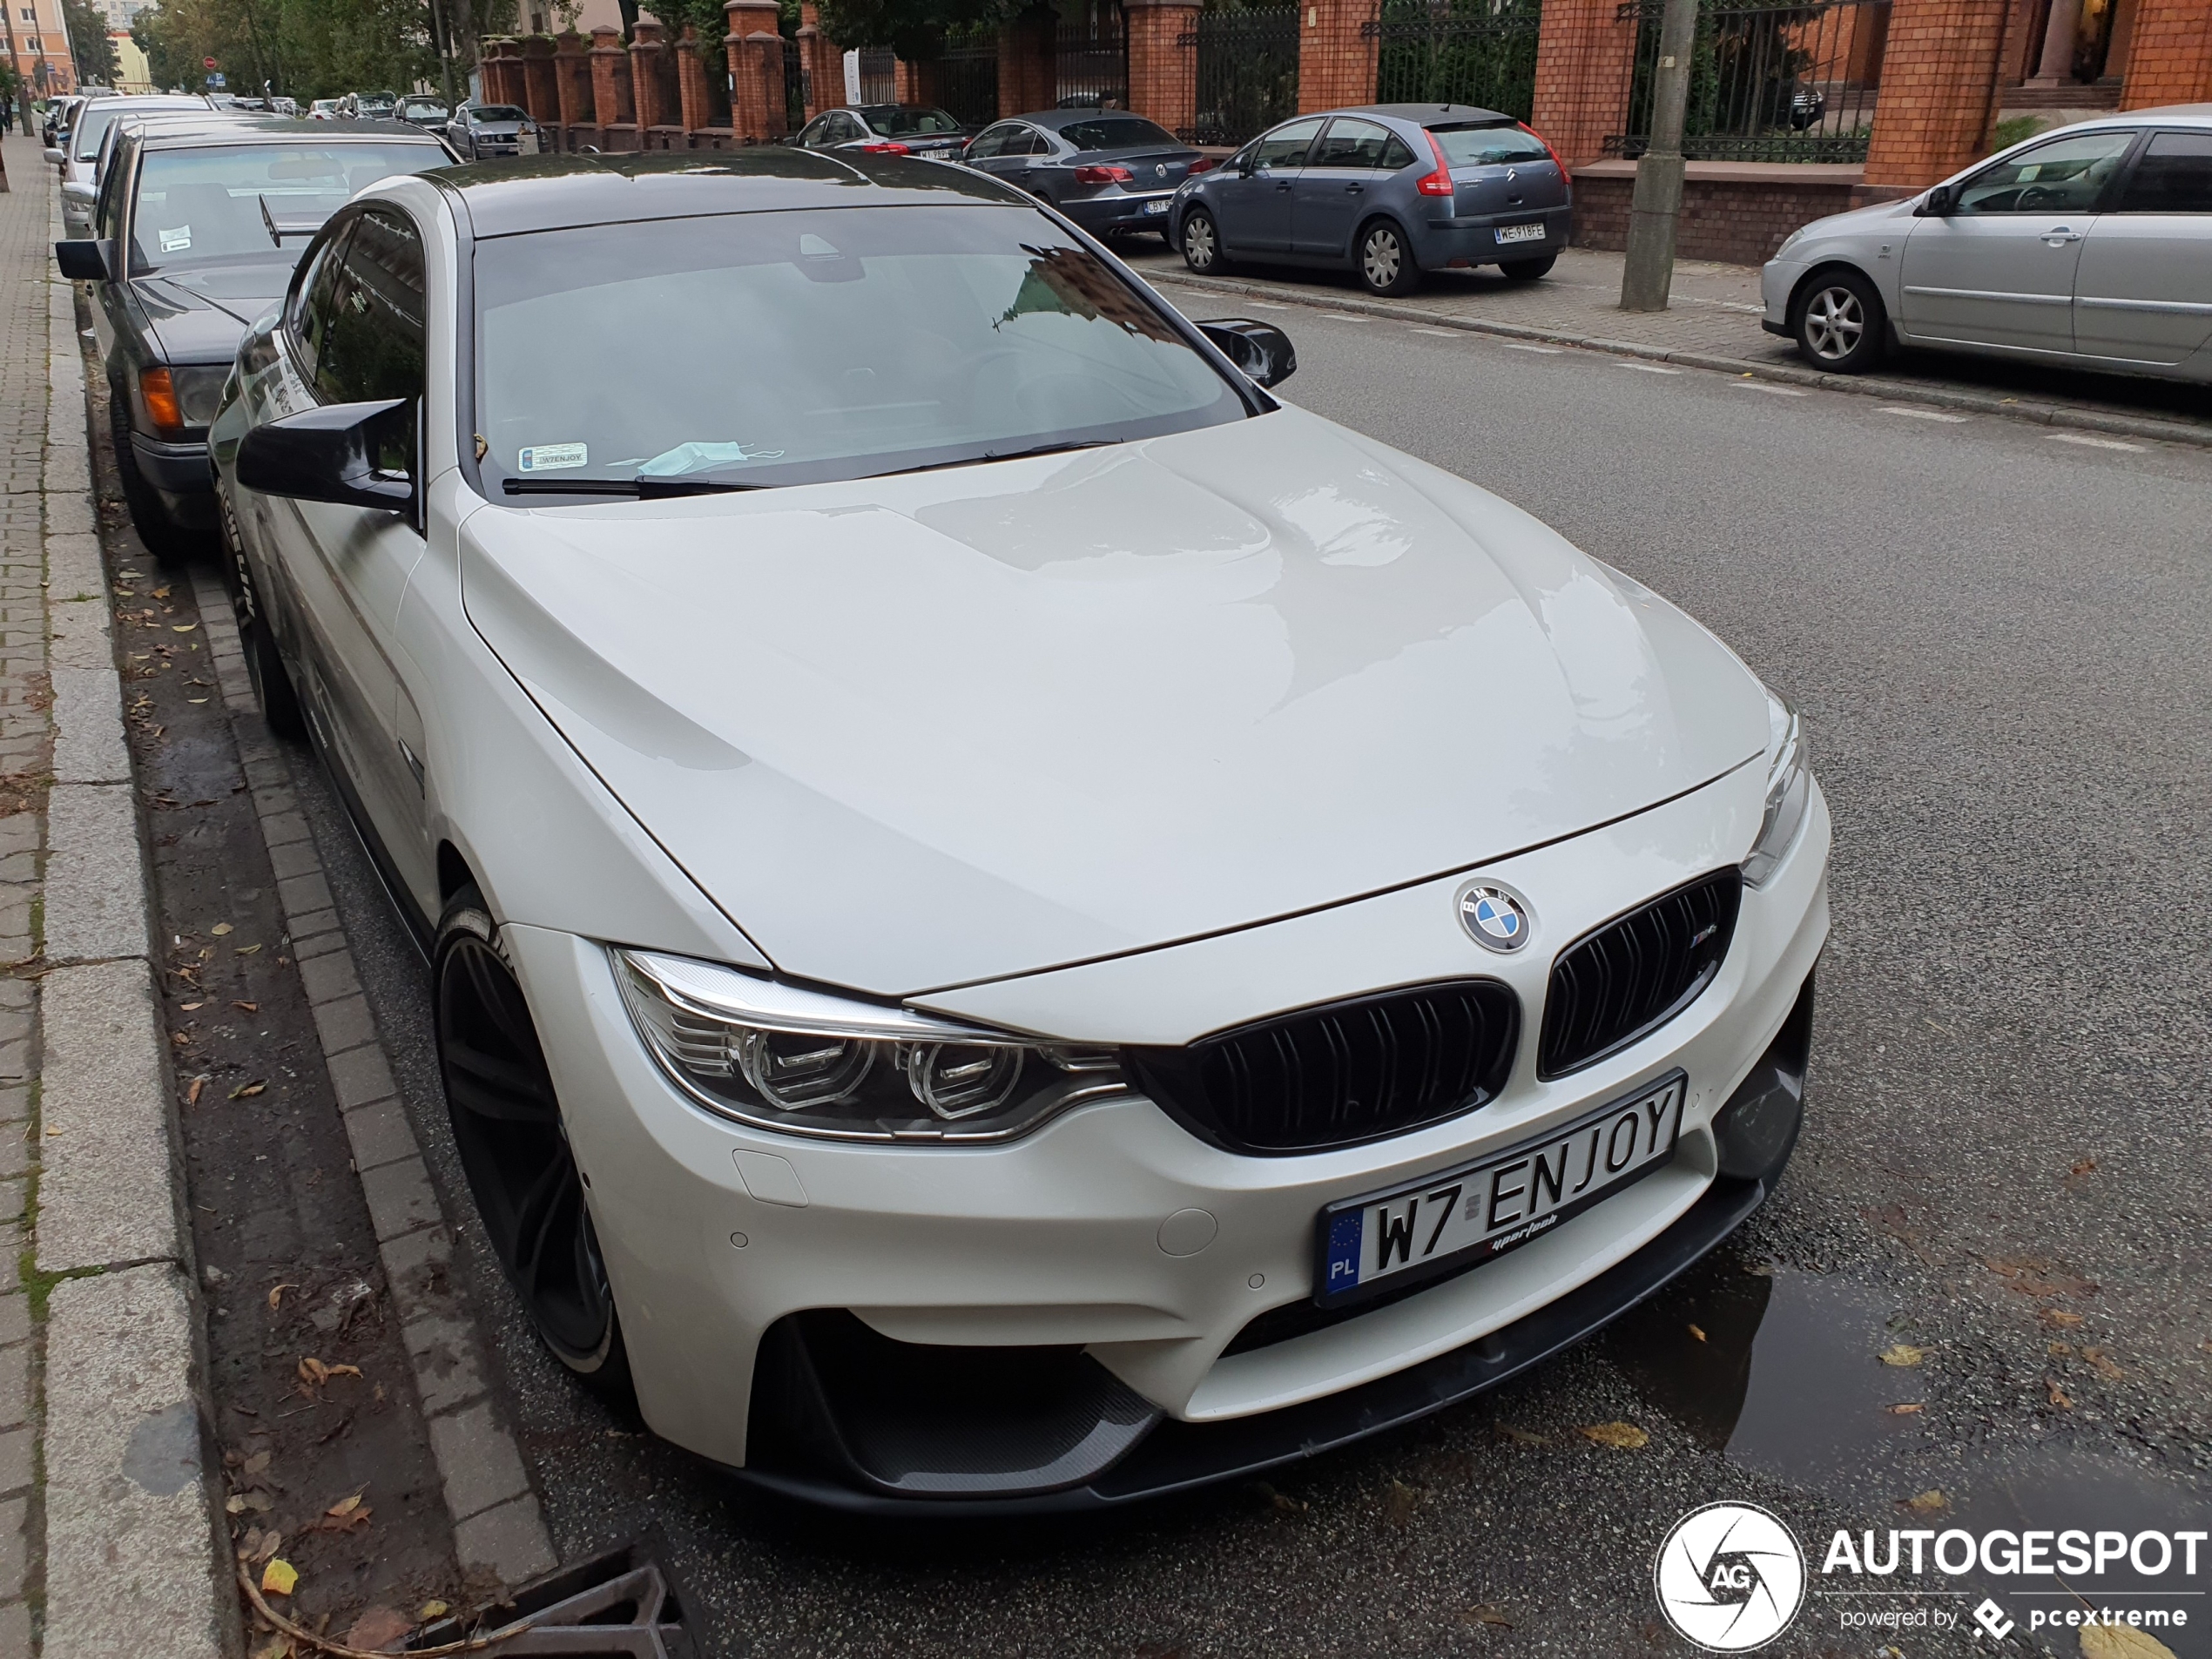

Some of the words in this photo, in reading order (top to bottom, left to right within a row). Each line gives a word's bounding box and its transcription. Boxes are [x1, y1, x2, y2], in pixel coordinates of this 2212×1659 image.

[1149, 201, 1163, 212] CBY
[1501, 228, 1515, 240] WE
[1516, 225, 1543, 238] 918FE
[543, 454, 582, 463] W7ENJOY
[218, 476, 255, 617] MICHELIN
[1462, 887, 1511, 914] BMW
[1378, 1184, 1462, 1271] W7
[1486, 1088, 1675, 1232] ENJOY
[1331, 1260, 1354, 1279] PL
